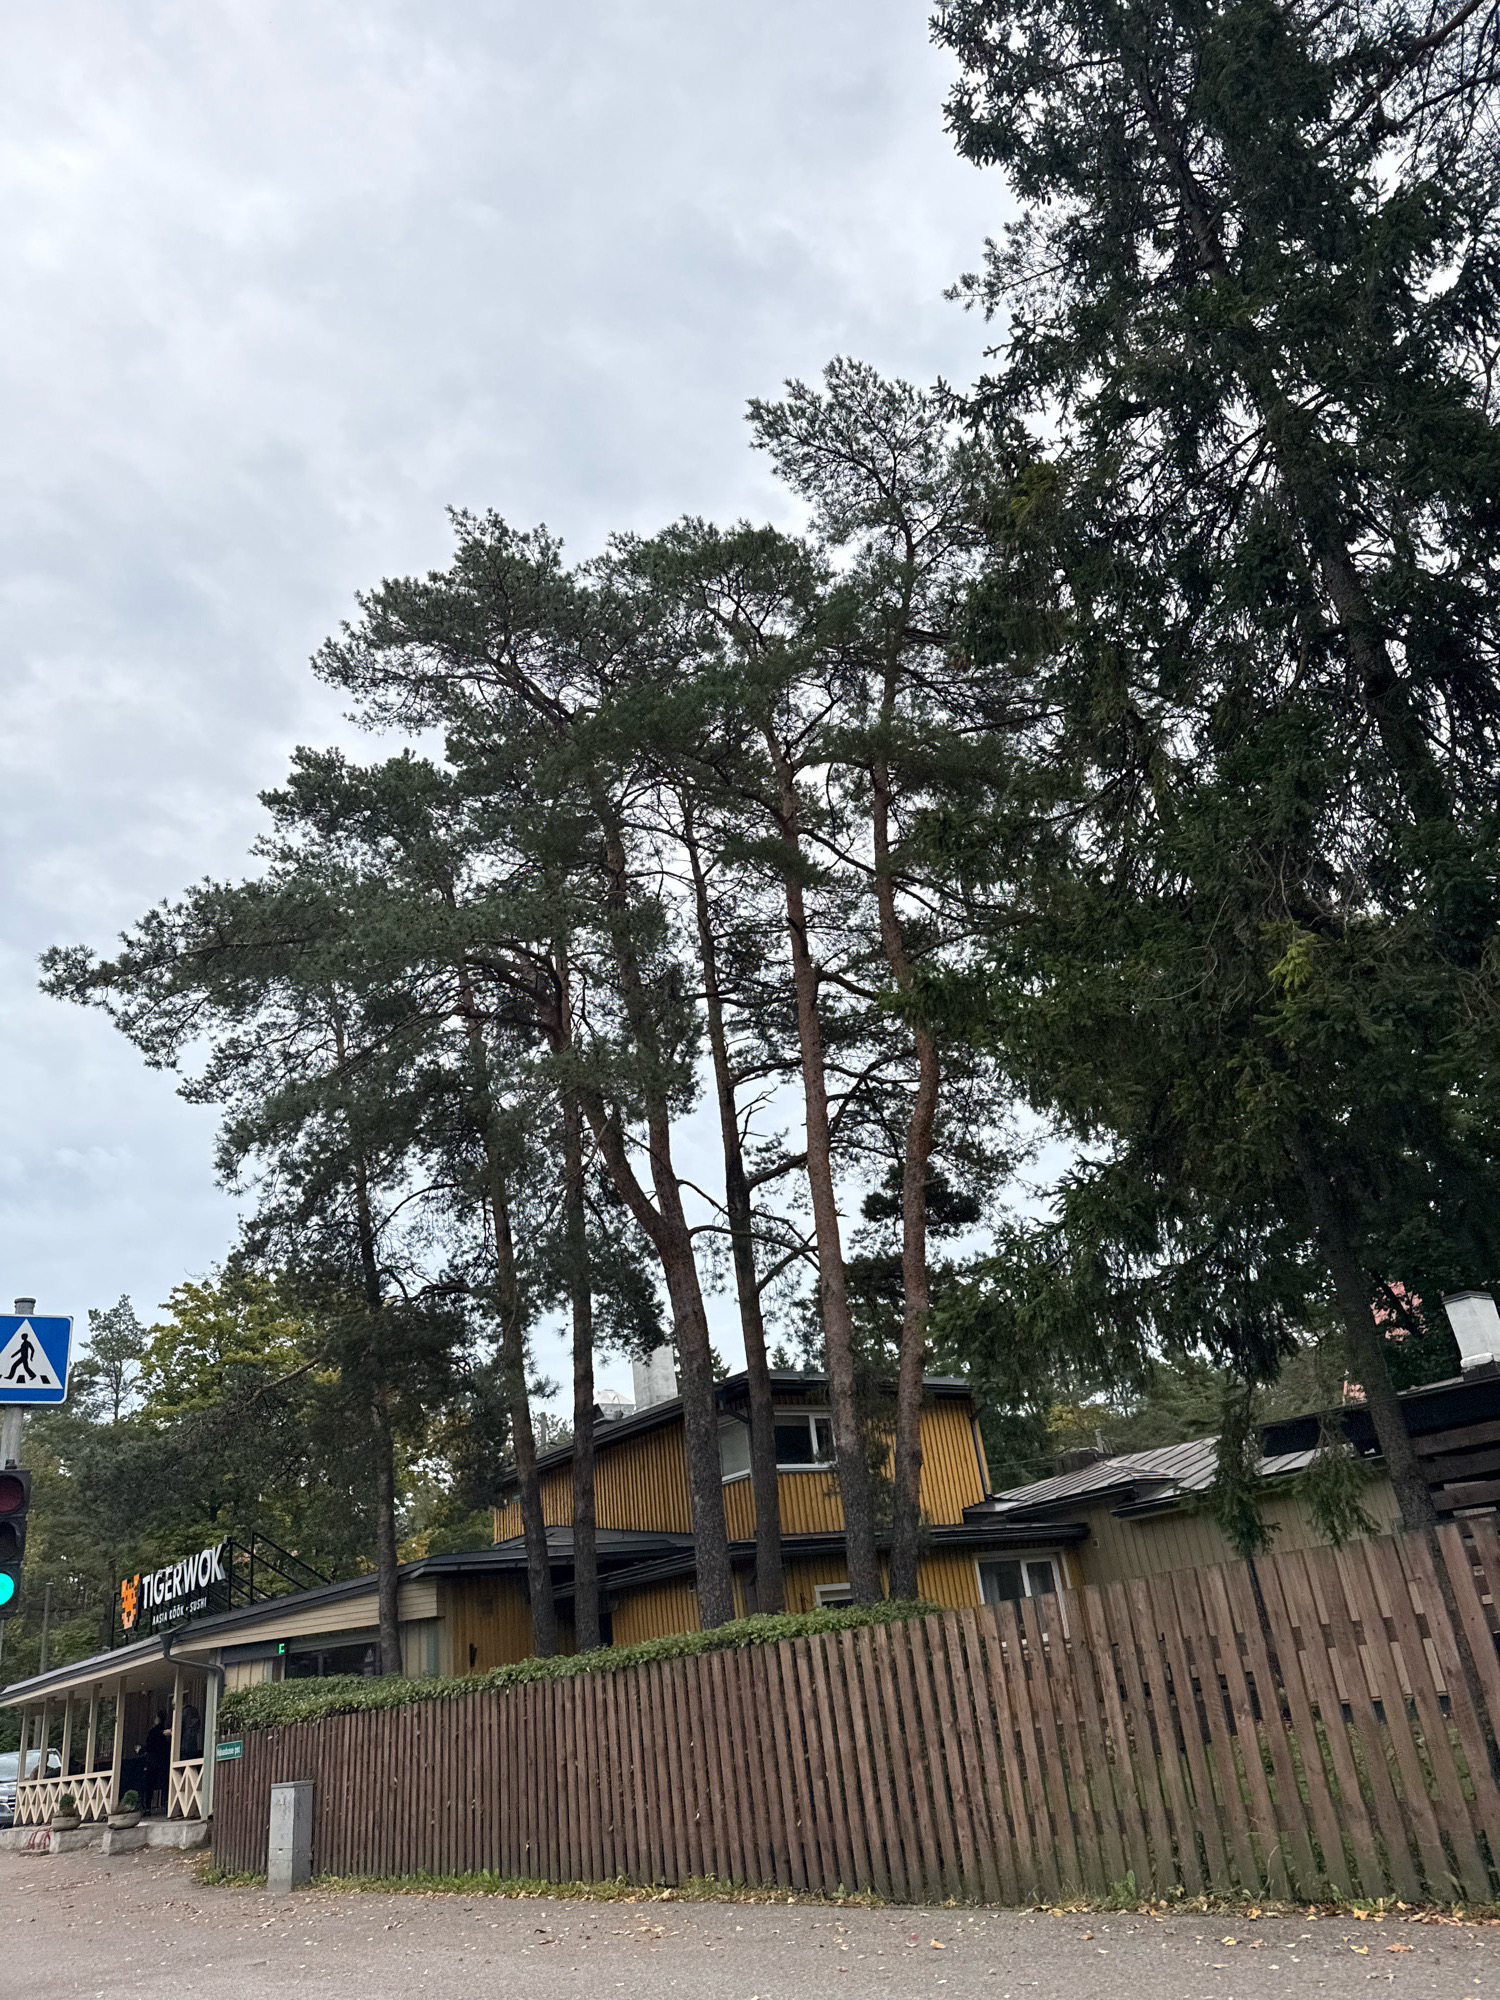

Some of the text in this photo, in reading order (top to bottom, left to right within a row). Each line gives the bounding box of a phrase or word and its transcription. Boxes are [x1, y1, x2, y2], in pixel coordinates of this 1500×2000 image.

[142, 1544, 226, 1609] TIGERWOK
[152, 1612, 168, 1625] AASIA
[190, 1597, 206, 1612] SUSHI
